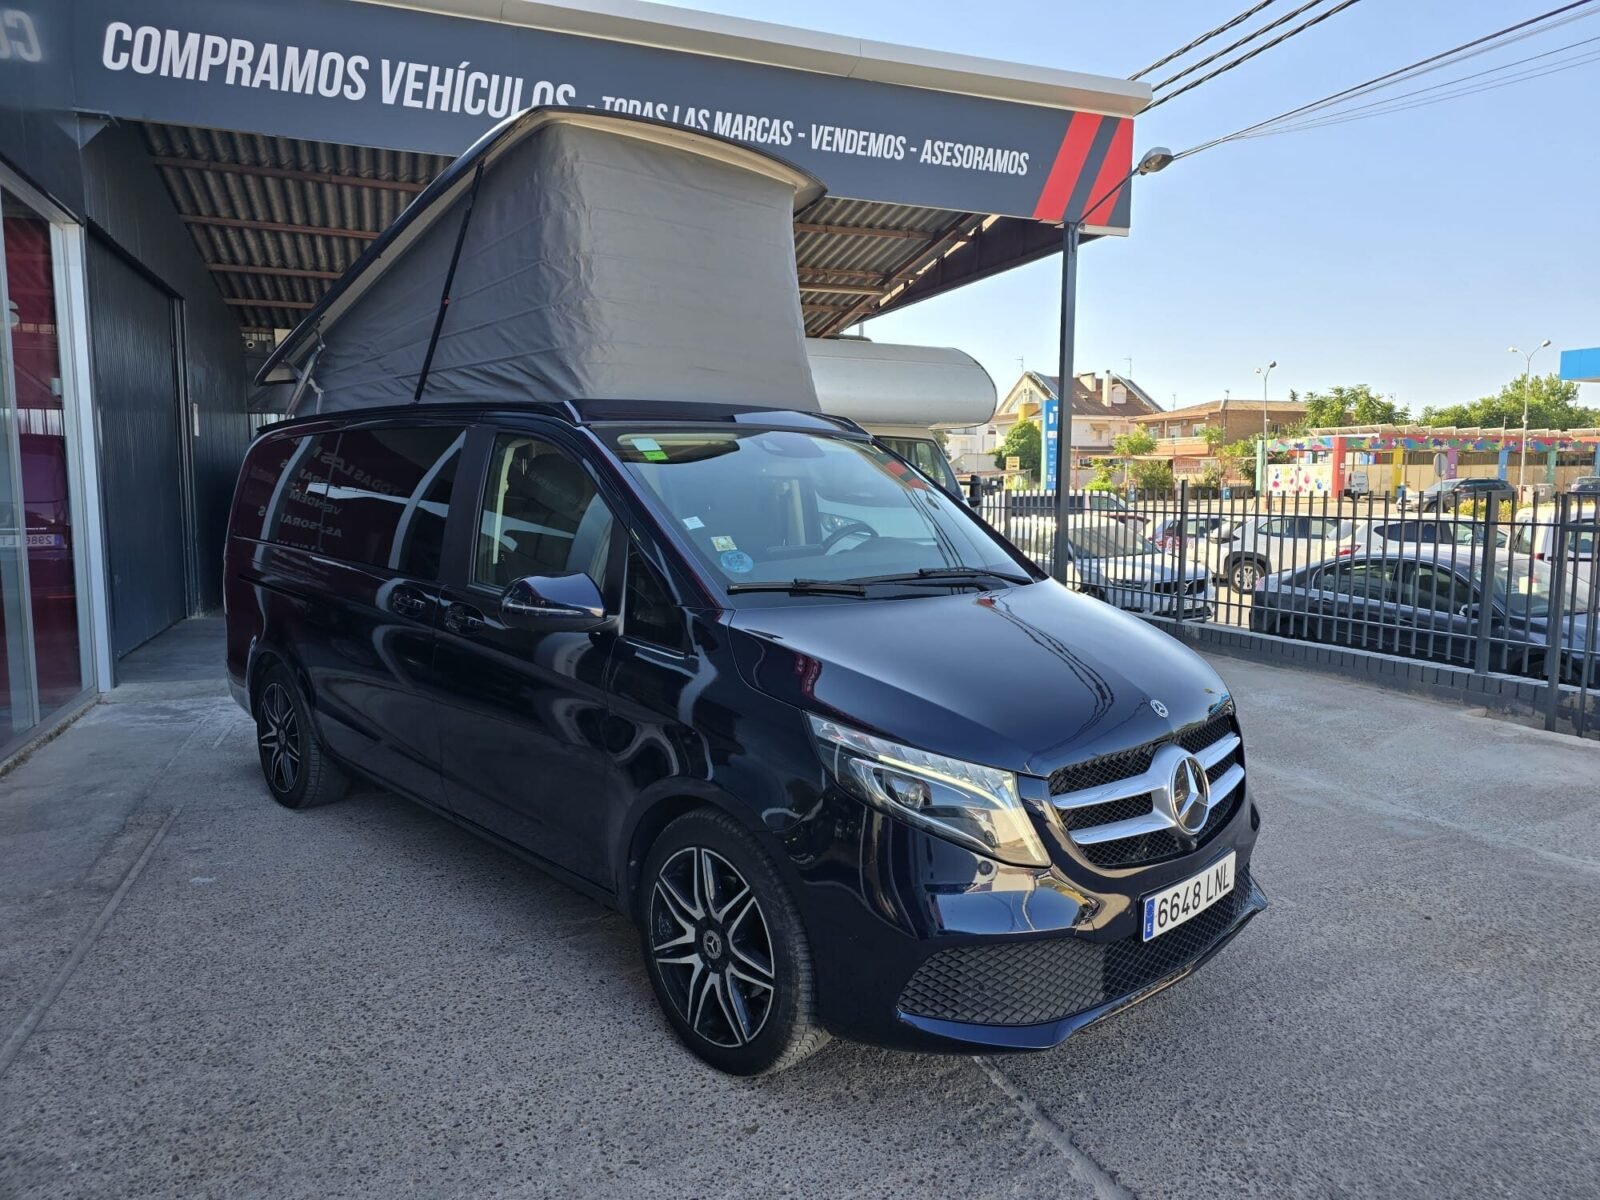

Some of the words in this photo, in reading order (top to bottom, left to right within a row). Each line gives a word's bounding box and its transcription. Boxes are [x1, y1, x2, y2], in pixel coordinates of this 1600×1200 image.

[102, 21, 369, 101] COMPRAMOS
[713, 110, 794, 147] MARCAS
[810, 124, 907, 161] VENDEMOS
[919, 139, 1030, 177] ASESORAMOS
[1157, 881, 1201, 928] 6648
[1206, 863, 1230, 903] LNL
